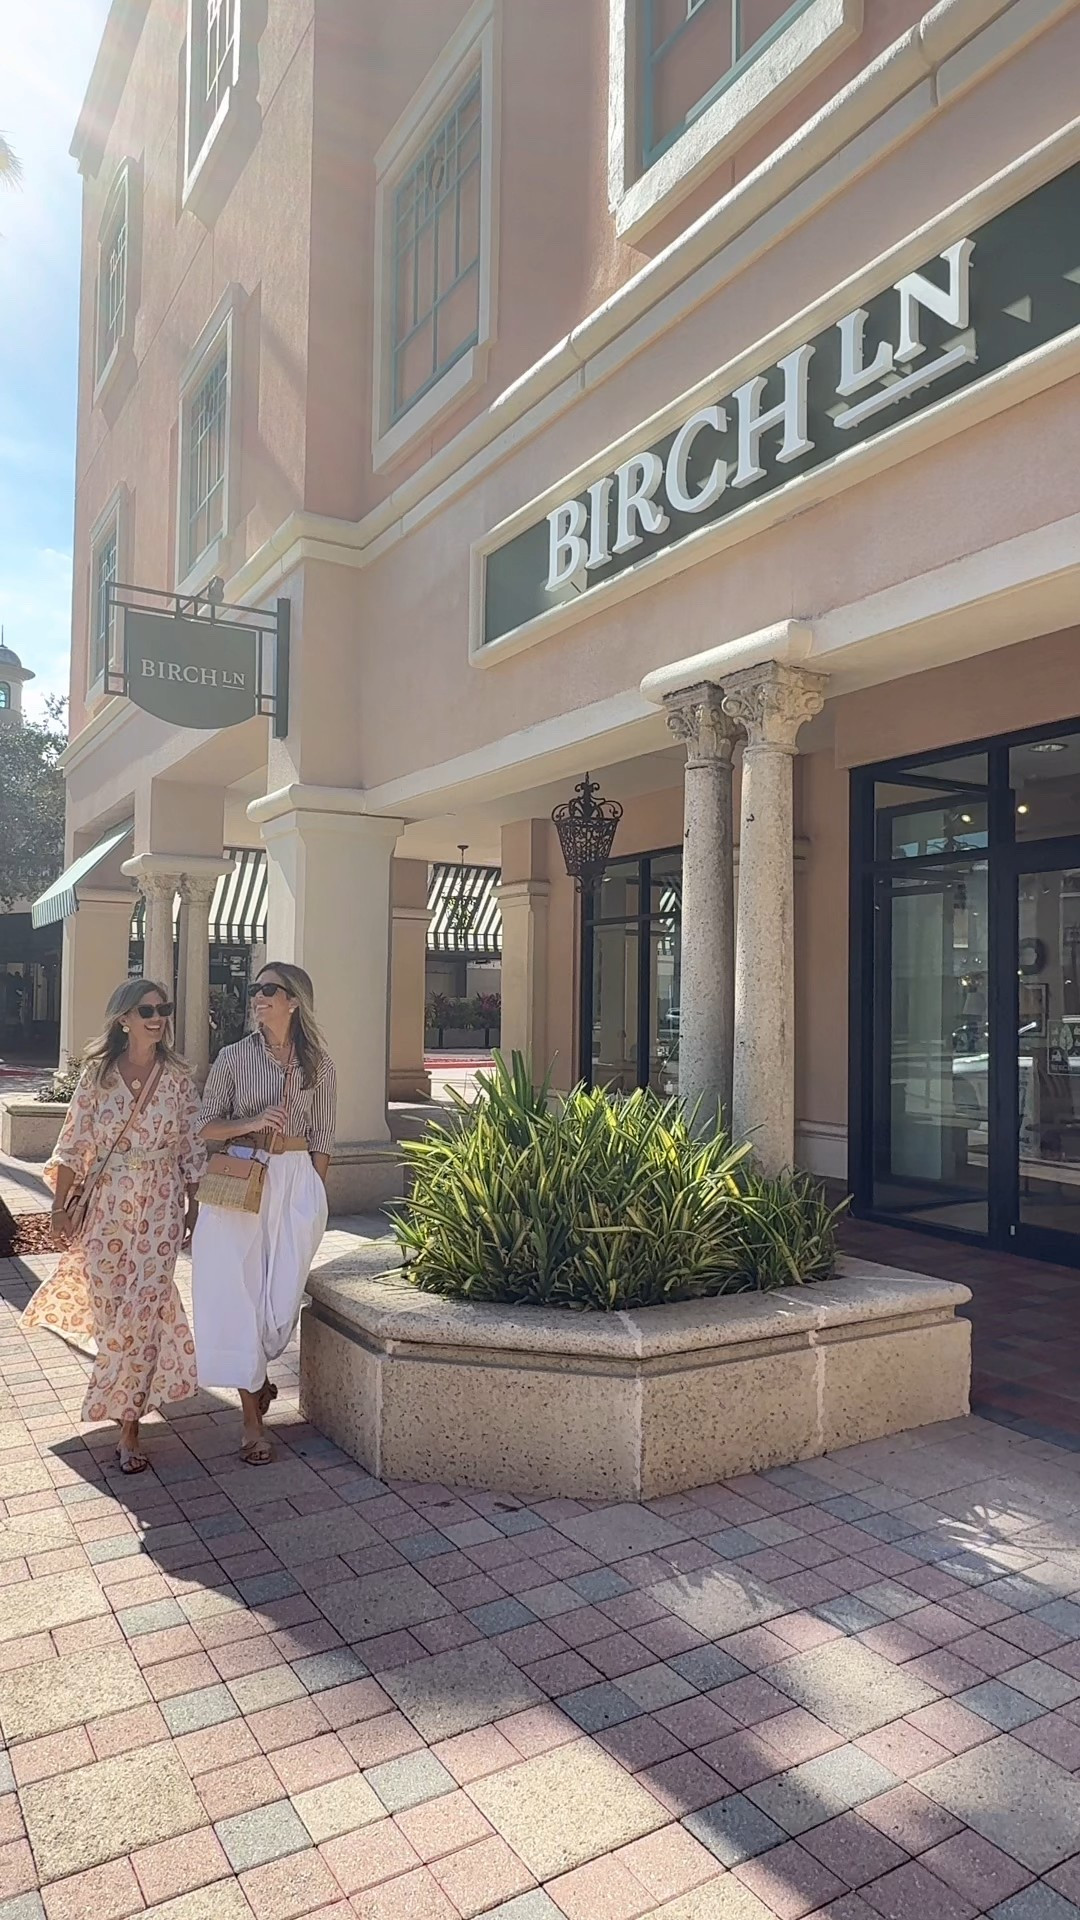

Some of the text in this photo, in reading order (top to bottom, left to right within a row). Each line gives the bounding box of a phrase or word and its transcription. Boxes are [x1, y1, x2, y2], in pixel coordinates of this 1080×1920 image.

[545, 238, 976, 592] BIRCH LN
[141, 658, 246, 687] BIRCH LN
